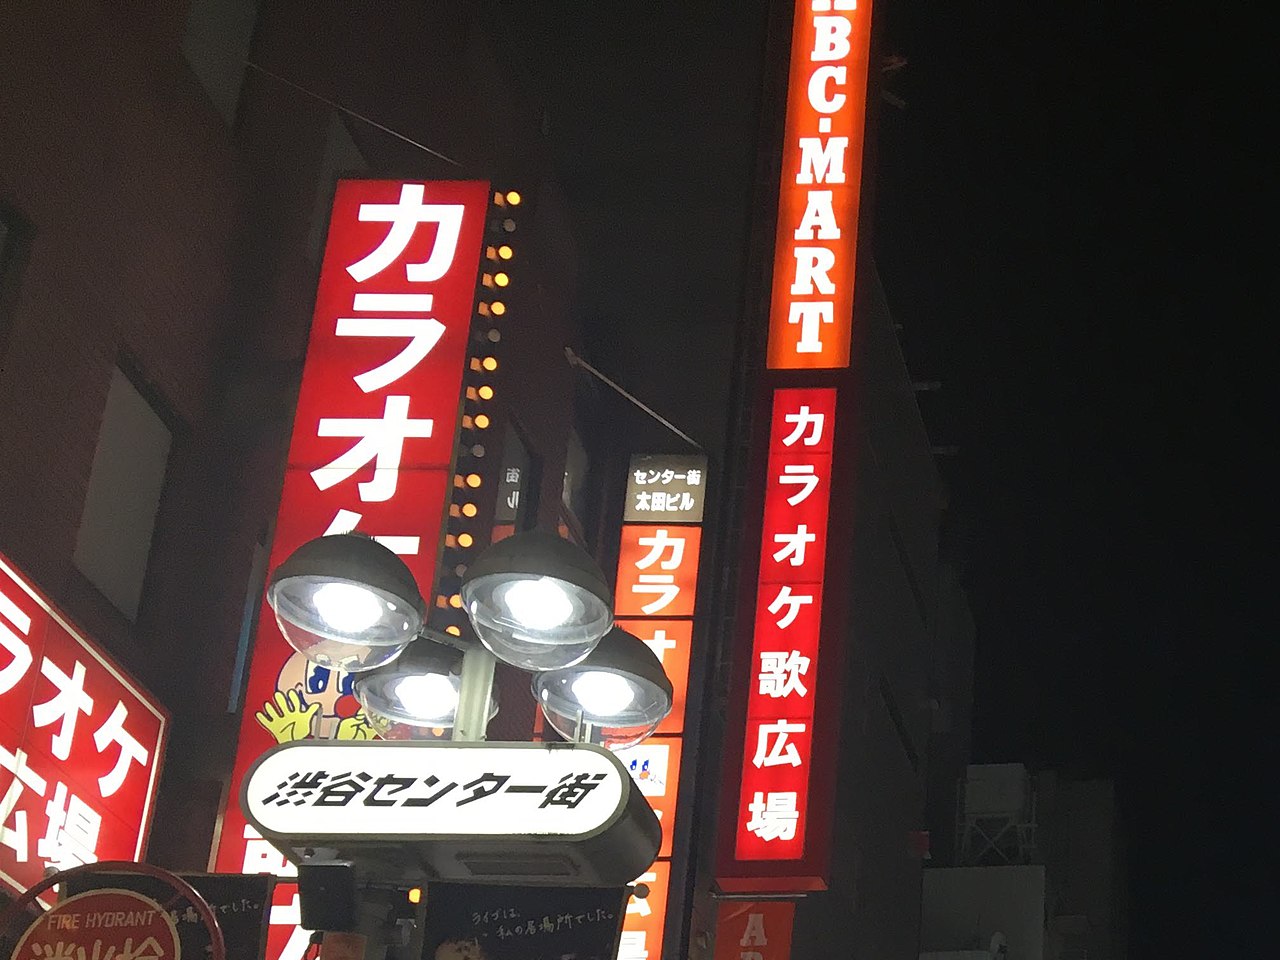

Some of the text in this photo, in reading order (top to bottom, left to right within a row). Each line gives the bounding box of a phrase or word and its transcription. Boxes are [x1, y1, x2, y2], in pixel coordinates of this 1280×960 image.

[634, 468, 700, 487] センター街
[746, 406, 825, 842] カラオケ歌広場
[262, 771, 606, 811] 渋谷センター街
[47, 910, 157, 930] FIRE HYDRANT
